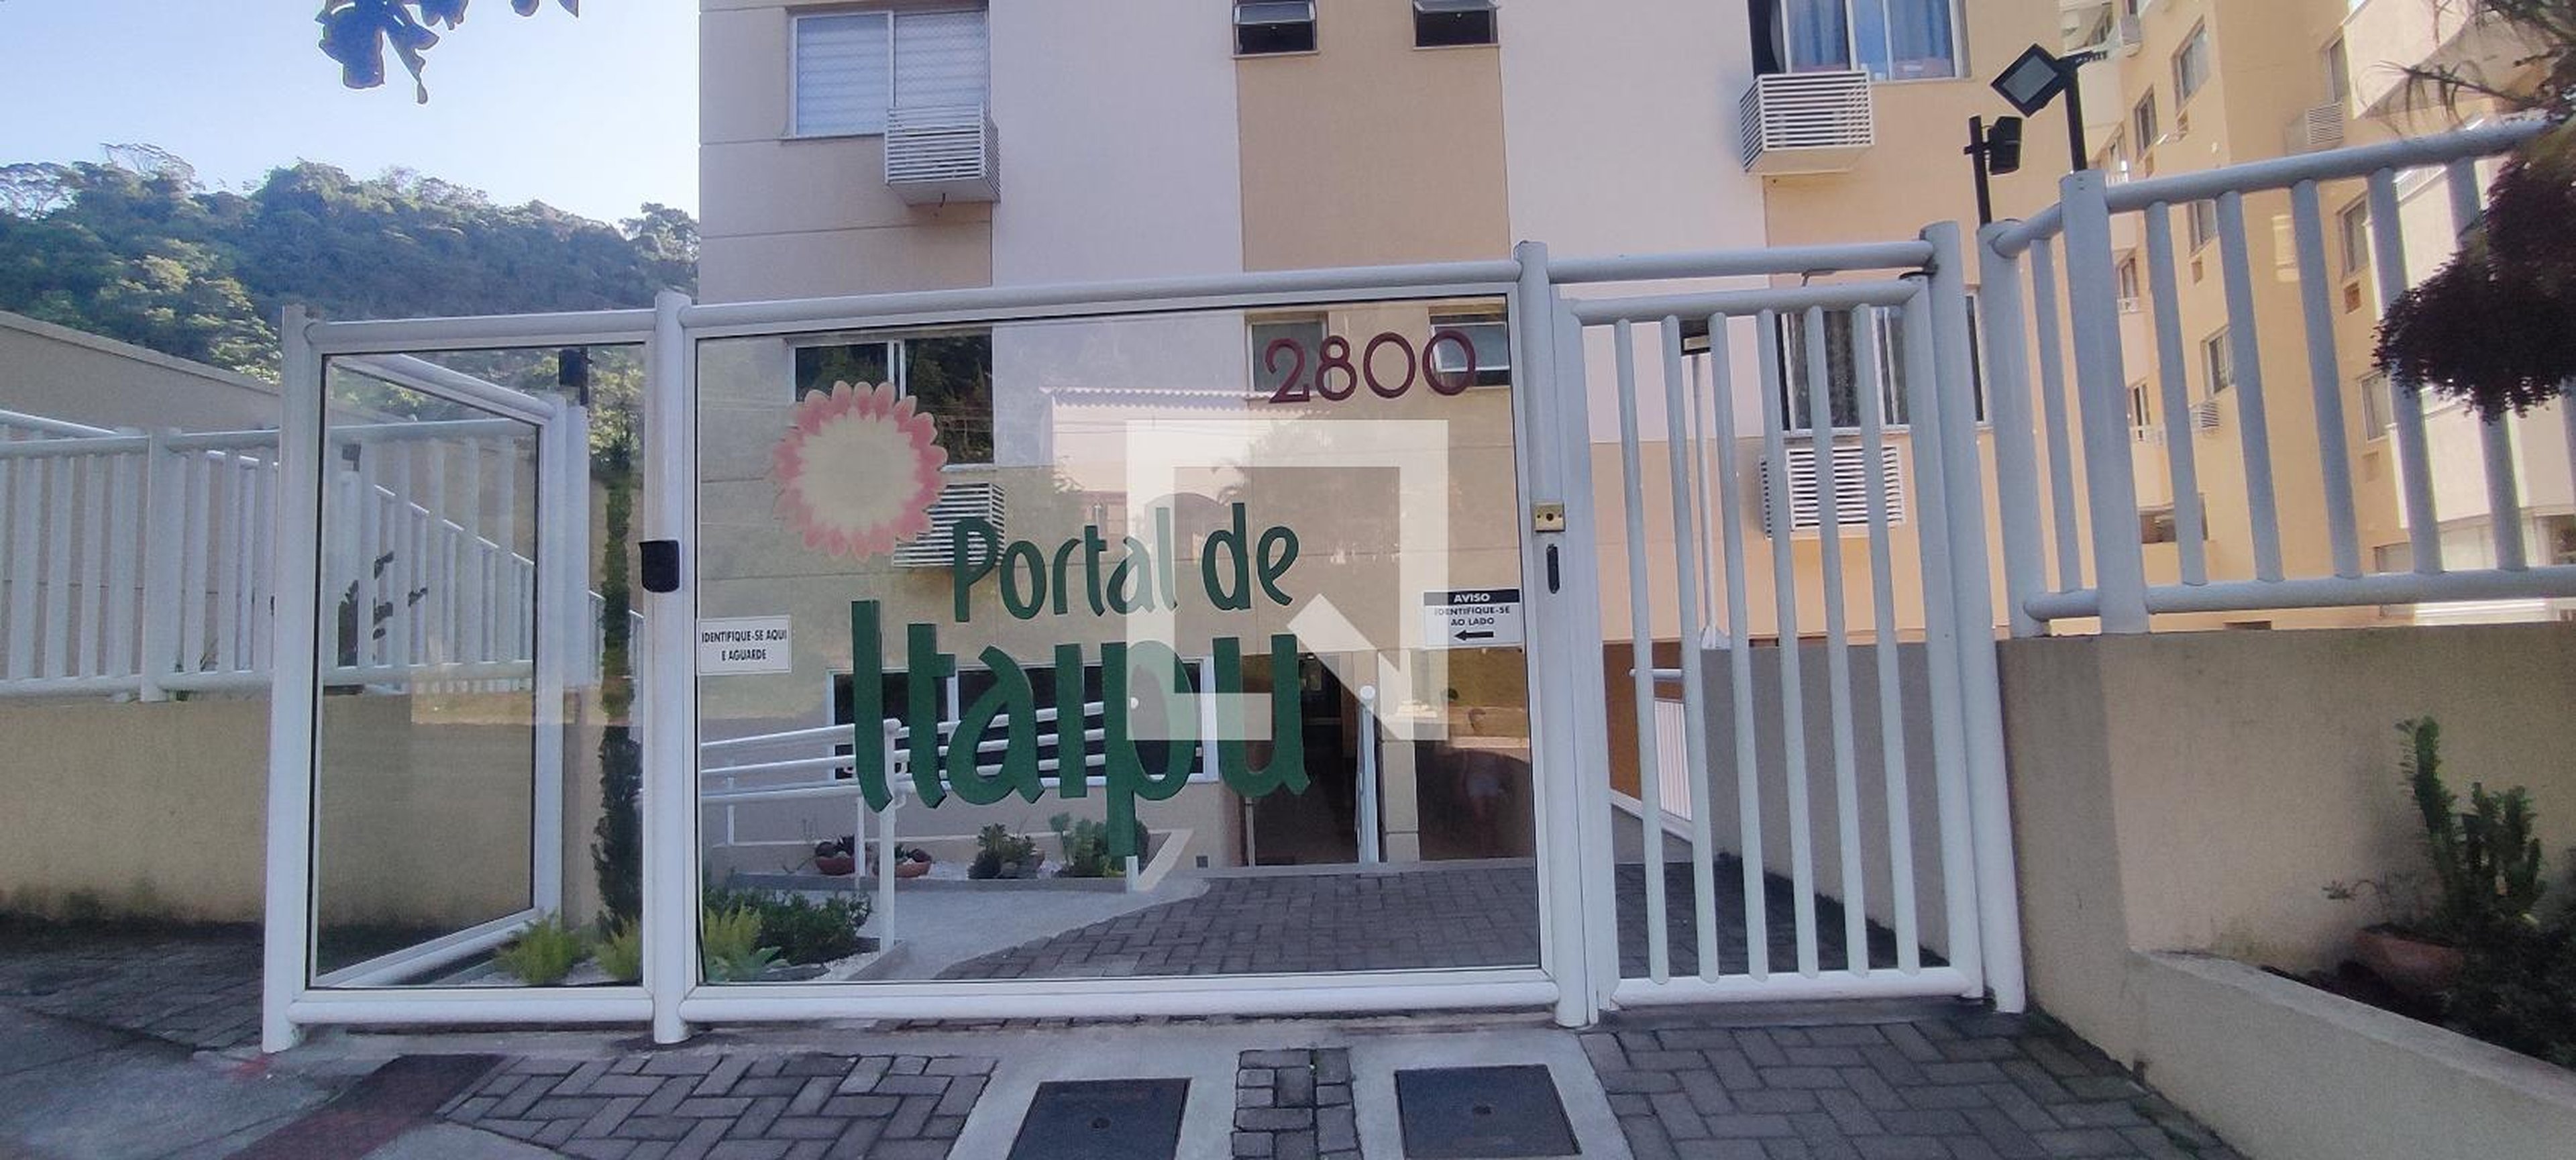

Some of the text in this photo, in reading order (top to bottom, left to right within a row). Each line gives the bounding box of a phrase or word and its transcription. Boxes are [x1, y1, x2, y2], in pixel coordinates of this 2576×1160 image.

[1265, 329, 1476, 403] 2800
[953, 503, 1299, 623] Portal de
[1454, 593, 1491, 602] AVISO
[1434, 606, 1510, 616] IDENTIFIQUE-SE
[1468, 617, 1495, 626] LADO
[702, 629, 787, 643] IDENTIFIQUE-SE AQUI
[721, 649, 766, 661] E AGUARDE
[851, 600, 1311, 859] Itaipu
